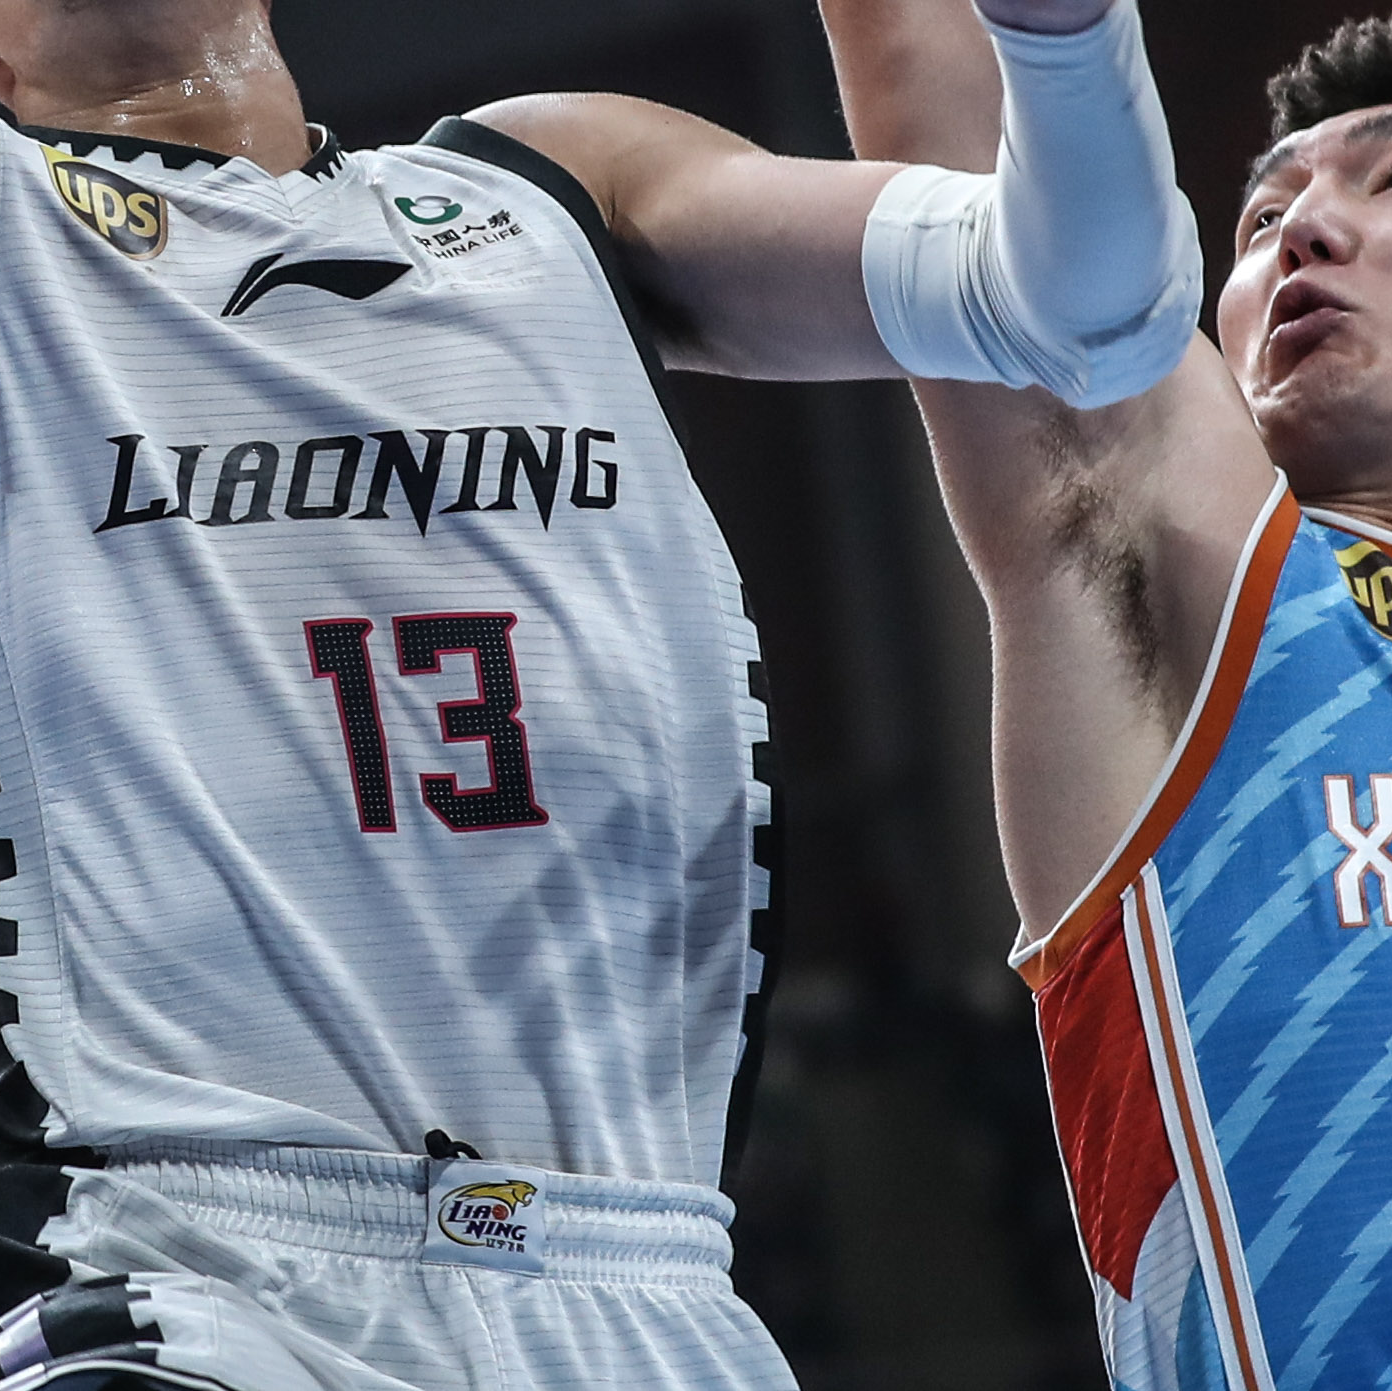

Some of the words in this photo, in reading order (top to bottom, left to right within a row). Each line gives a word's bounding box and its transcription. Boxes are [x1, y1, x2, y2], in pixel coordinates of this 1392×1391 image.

[426, 239, 481, 260] HINA
[482, 223, 524, 245] LIFE
[92, 425, 618, 538] LIAONING
[302, 612, 549, 833] 13
[463, 1221, 527, 1241] NING
